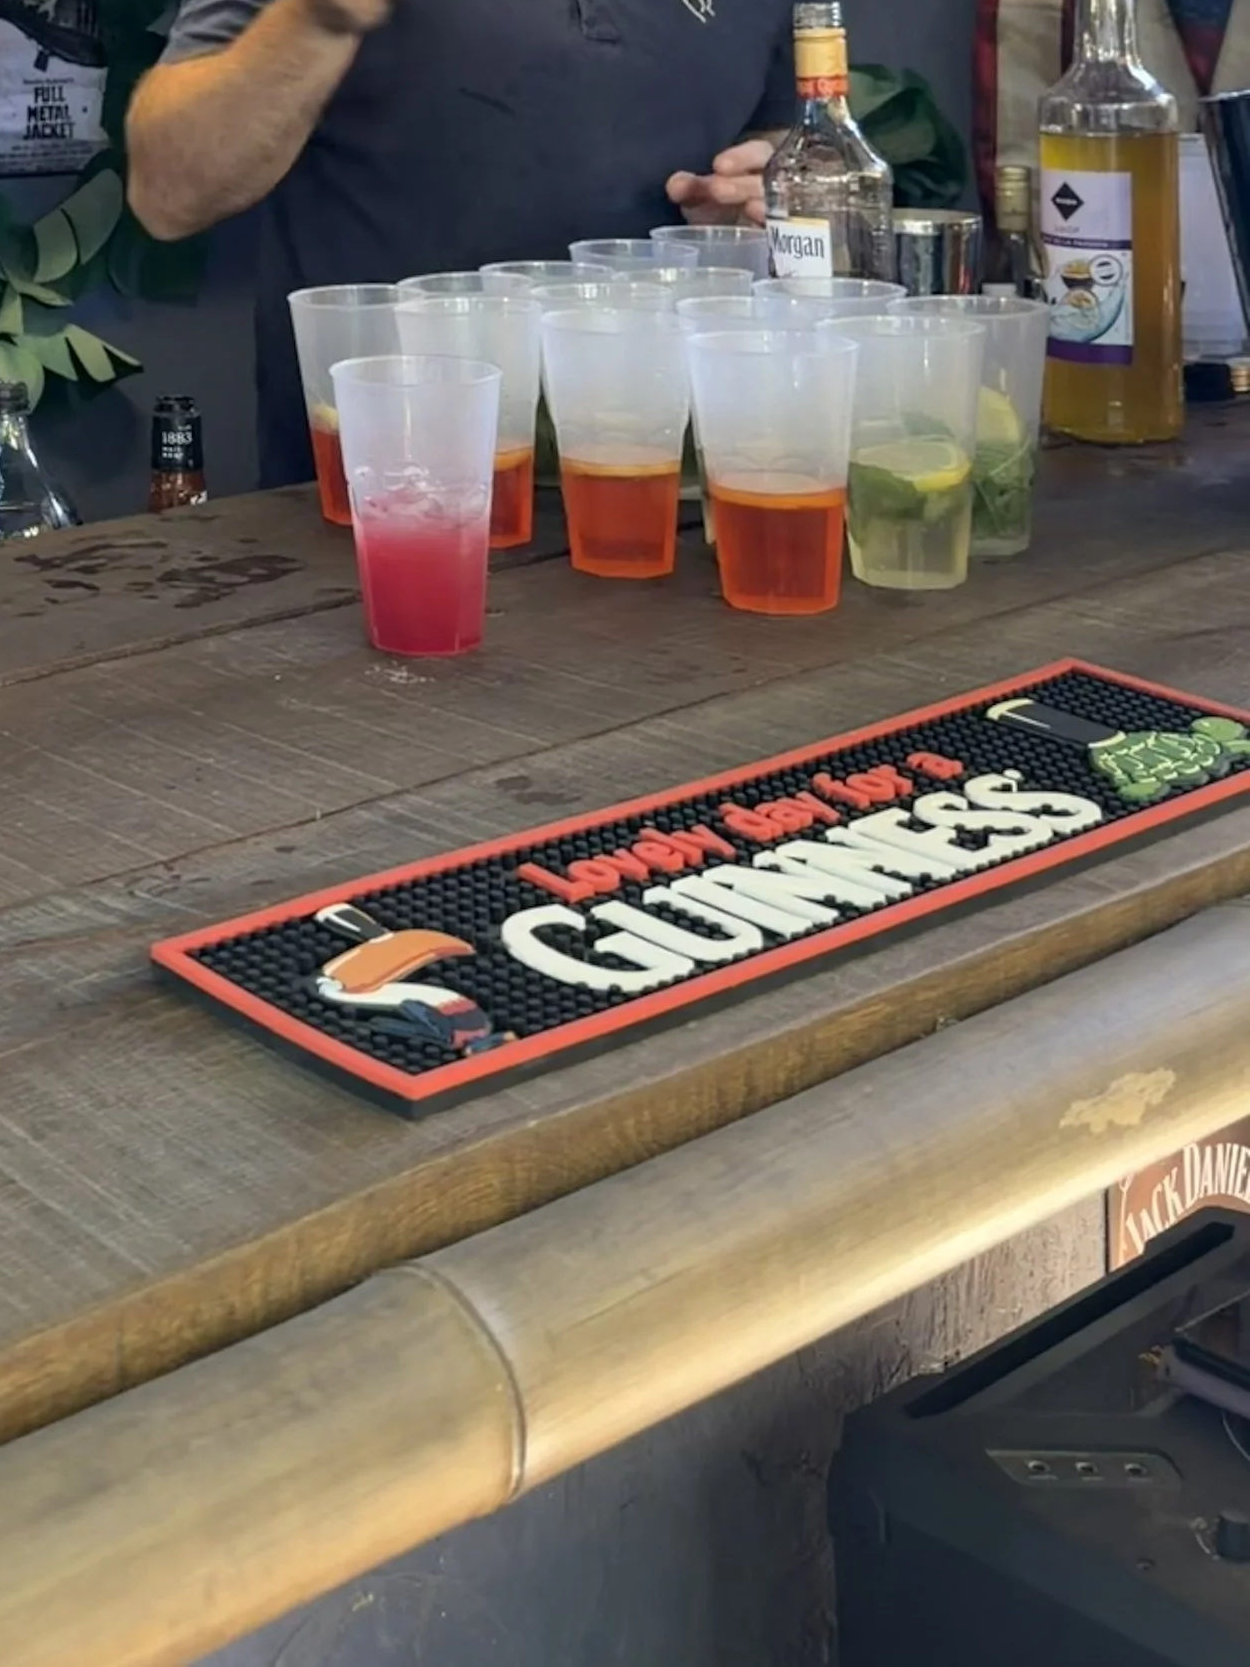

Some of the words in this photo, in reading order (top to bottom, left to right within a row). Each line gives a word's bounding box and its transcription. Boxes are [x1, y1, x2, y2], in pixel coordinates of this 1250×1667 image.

[27, 105, 71, 123] METAL
[34, 86, 66, 103] FULL
[23, 122, 75, 140] JACKET
[516, 823, 736, 903] Lovely
[718, 792, 840, 843] day
[811, 762, 915, 810] for
[906, 751, 964, 781] a
[501, 771, 1102, 992] GUINNESS
[1126, 1166, 1184, 1255] JACK
[1183, 1140, 1250, 1210] DANIE
